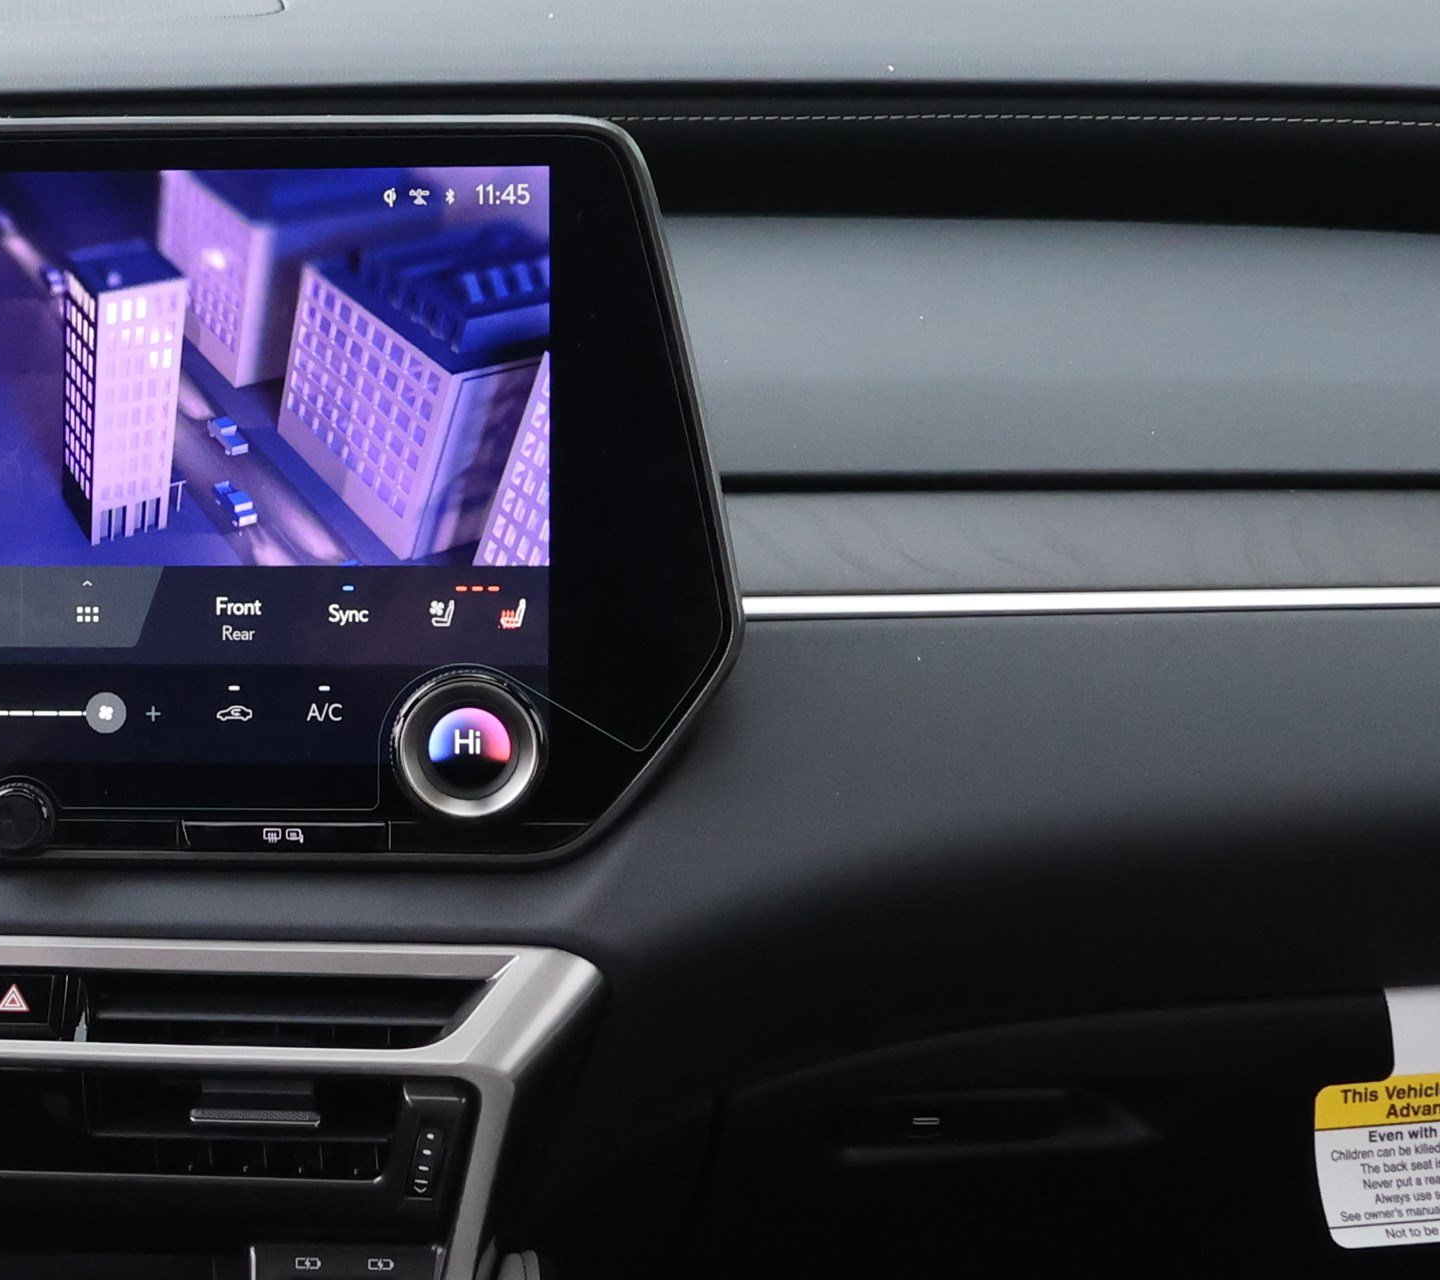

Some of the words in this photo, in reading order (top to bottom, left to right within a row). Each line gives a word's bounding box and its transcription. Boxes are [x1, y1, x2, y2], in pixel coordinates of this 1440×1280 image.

[475, 183, 531, 205] 11:45
[216, 596, 262, 616] Front
[328, 603, 369, 626] Sync
[222, 624, 256, 641] Rear
[306, 702, 343, 722] A/C
[454, 729, 481, 755] Hi
[1340, 1087, 1379, 1104] This
[1368, 1130, 1404, 1143] Even
[1408, 1127, 1437, 1139] with
[1331, 1148, 1374, 1162] Children
[1376, 1148, 1396, 1157] can
[1398, 1145, 1412, 1156] be
[1414, 1142, 1440, 1155] killed
[1360, 1163, 1380, 1175] The
[1383, 1161, 1408, 1173] back
[1411, 1158, 1433, 1171] seat
[1363, 1178, 1393, 1190] Never
[1396, 1176, 1413, 1189] put
[1415, 1177, 1422, 1186] a
[1375, 1191, 1411, 1205] Always
[1413, 1191, 1432, 1201] use
[1340, 1211, 1362, 1222] See
[1364, 1207, 1404, 1220] owner's
[1385, 1227, 1408, 1239] Not
[1409, 1226, 1421, 1237] to
[1425, 1224, 1439, 1236] be
